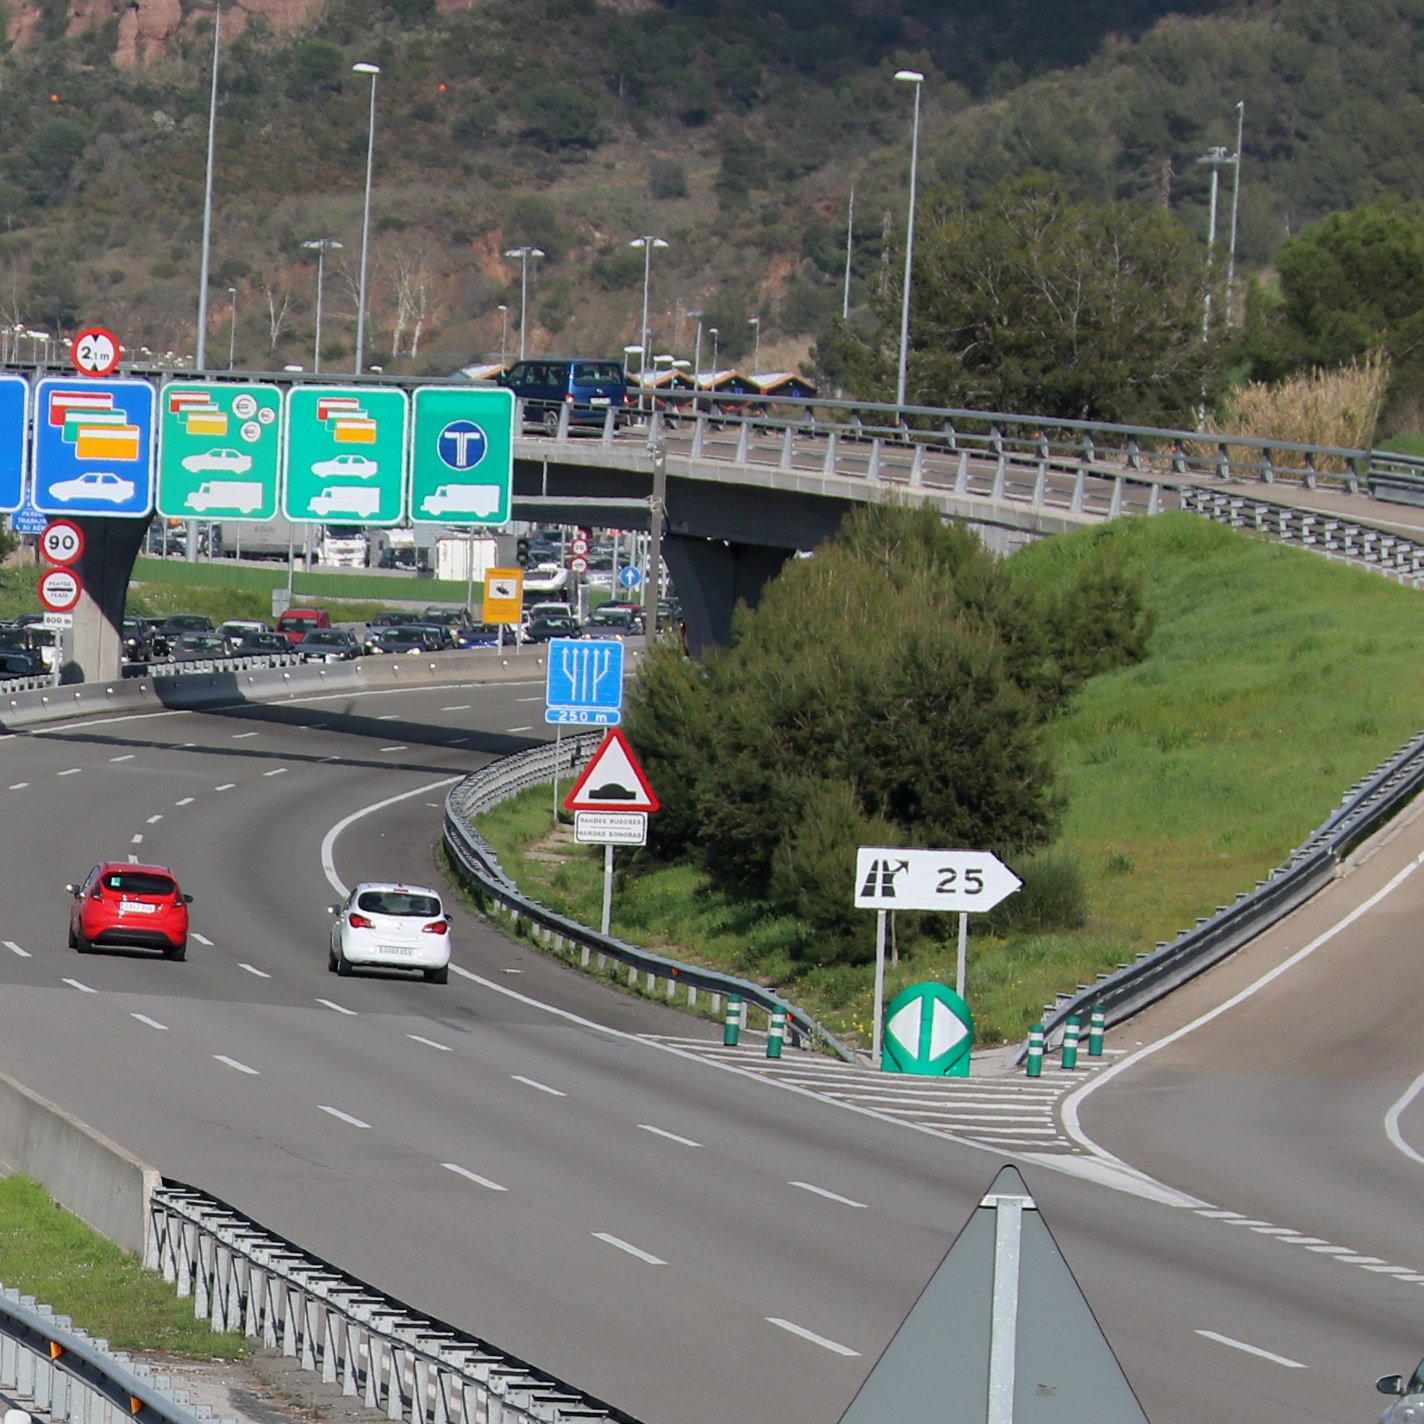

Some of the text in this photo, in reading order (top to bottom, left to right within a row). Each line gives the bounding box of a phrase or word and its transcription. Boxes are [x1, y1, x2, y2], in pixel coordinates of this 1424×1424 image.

[48, 535, 75, 550] 90
[558, 710, 608, 723] 250 m
[935, 867, 984, 895] 25
